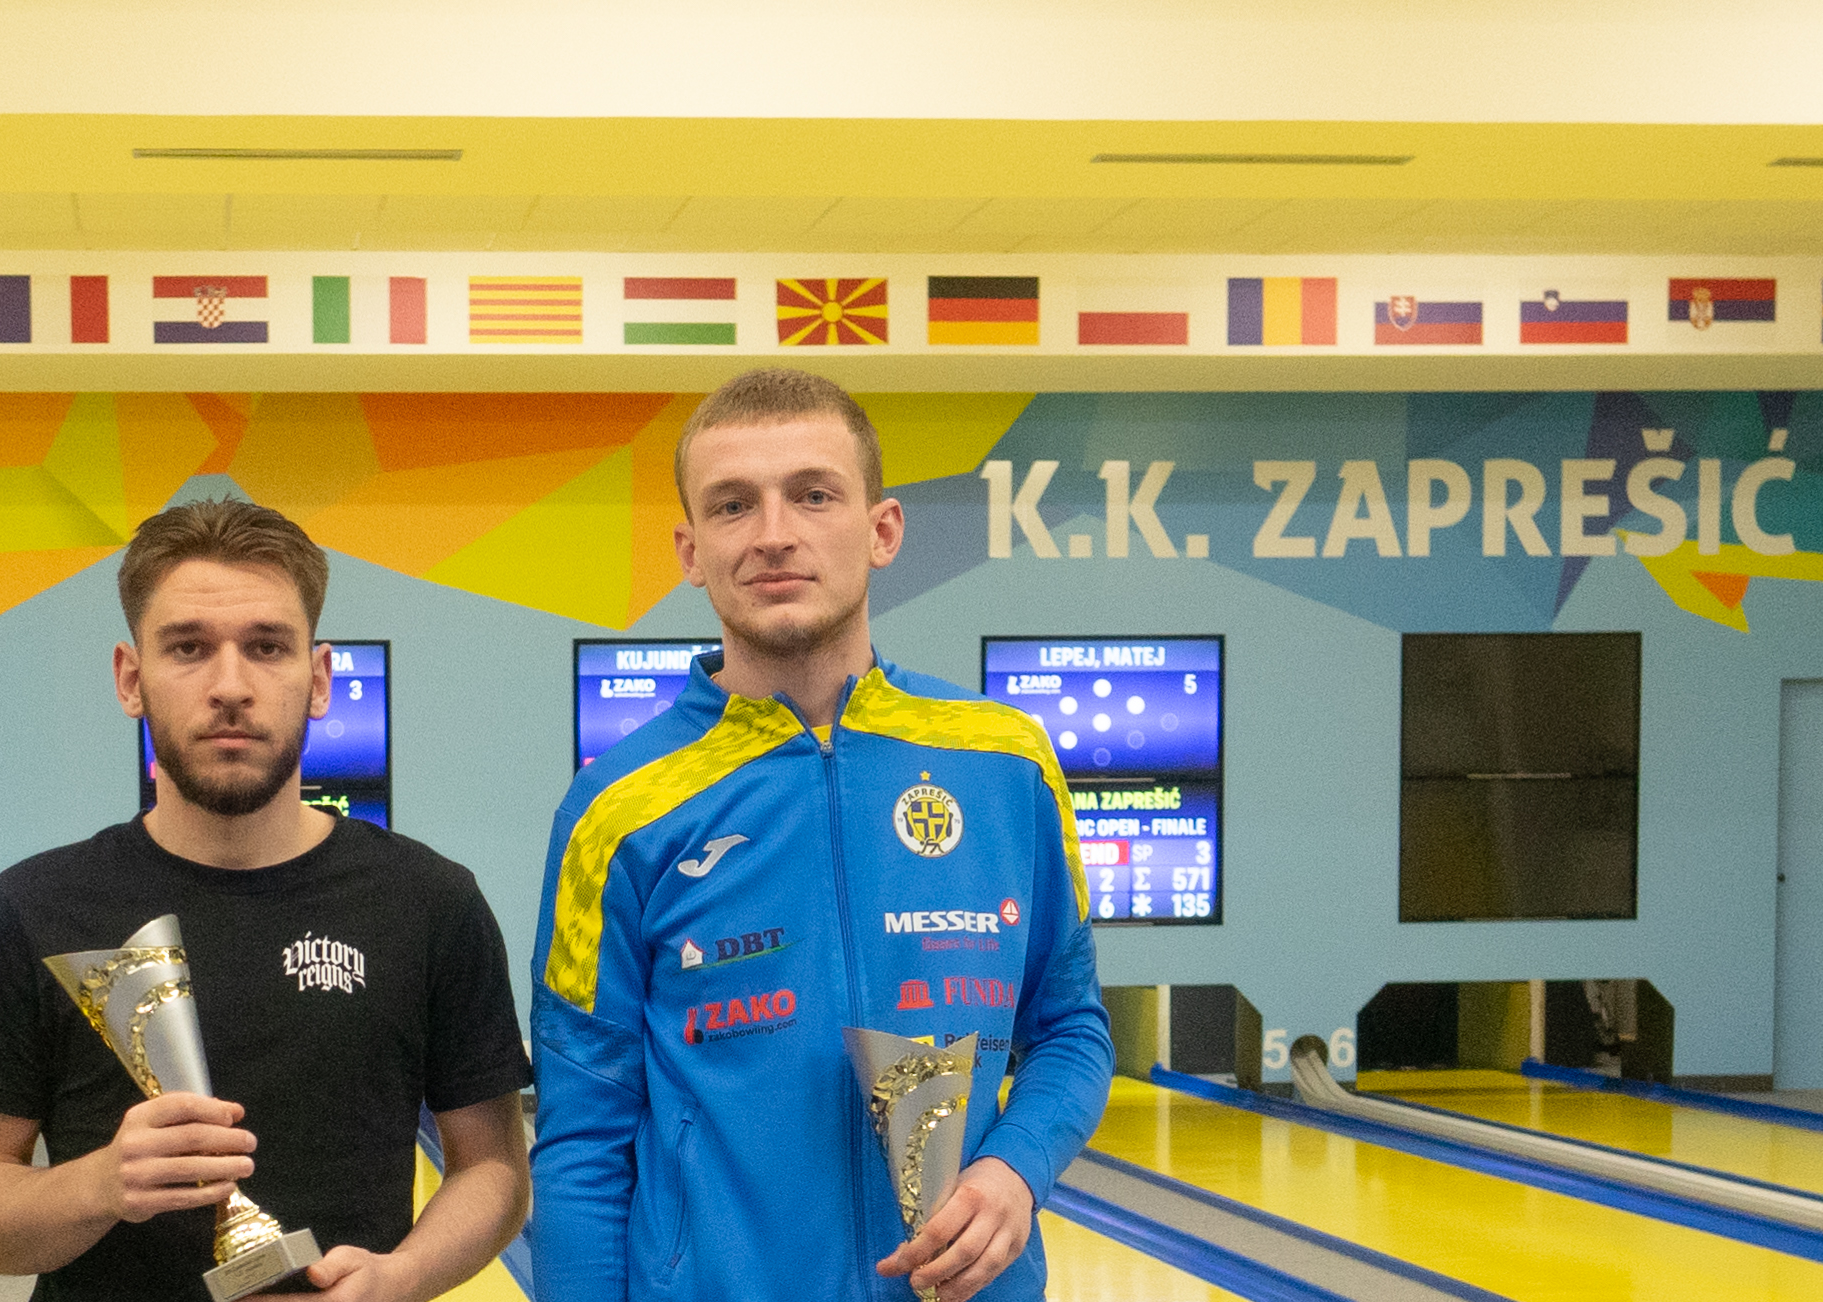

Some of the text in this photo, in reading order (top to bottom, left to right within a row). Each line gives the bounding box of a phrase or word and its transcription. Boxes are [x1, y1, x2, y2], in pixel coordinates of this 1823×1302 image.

[979, 428, 1797, 559] K.K. ZAPREŠIĆ
[1040, 647, 1165, 668] LEPEJ, MATEJ
[349, 680, 363, 700] 3
[613, 679, 656, 692] ZAKO
[1021, 675, 1062, 689] ZAKO
[1184, 673, 1197, 694] 5
[1100, 786, 1181, 810] ZAPREŠIĆ
[1097, 818, 1140, 836] OPEN
[1151, 818, 1207, 836] FINALE
[1081, 842, 1119, 865] END
[1132, 840, 1211, 865] SP 3
[1099, 867, 1115, 892] 2
[1172, 867, 1210, 891] 571
[1098, 894, 1115, 919] 6
[1172, 893, 1211, 917] 135
[884, 910, 1000, 934] MESSER
[715, 927, 785, 961] DBT
[704, 989, 796, 1030] ZAKO
[708, 1018, 797, 1042] zakobowling.com
[1263, 1029, 1289, 1069] 5
[1330, 1027, 1356, 1067] 6
